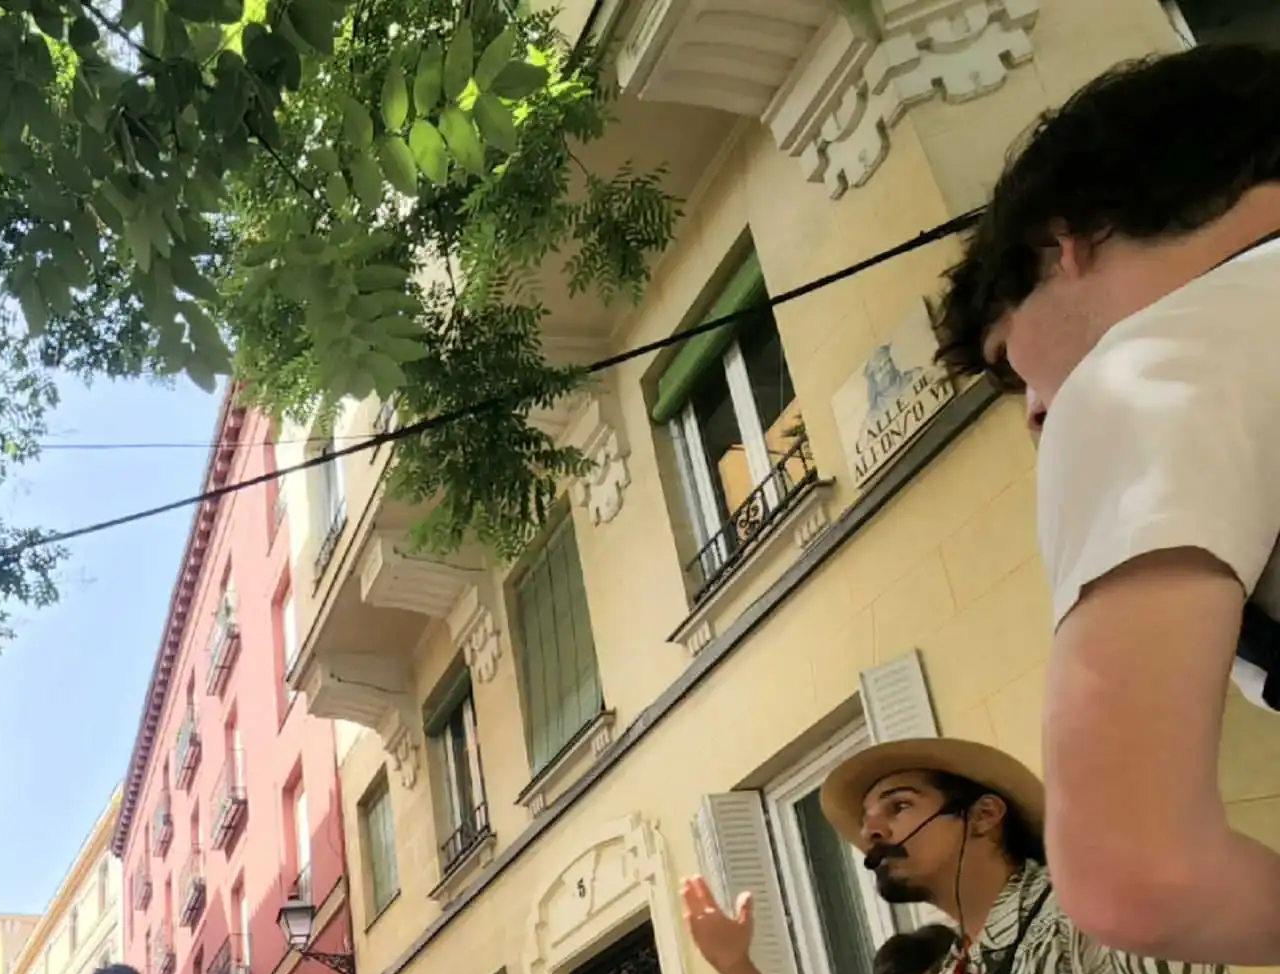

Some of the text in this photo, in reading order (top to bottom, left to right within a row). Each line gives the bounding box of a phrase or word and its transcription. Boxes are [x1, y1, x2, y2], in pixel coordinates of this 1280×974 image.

[854, 400, 924, 482] ALFONSO
[855, 398, 910, 454] CALLE
[577, 878, 586, 898] 5
